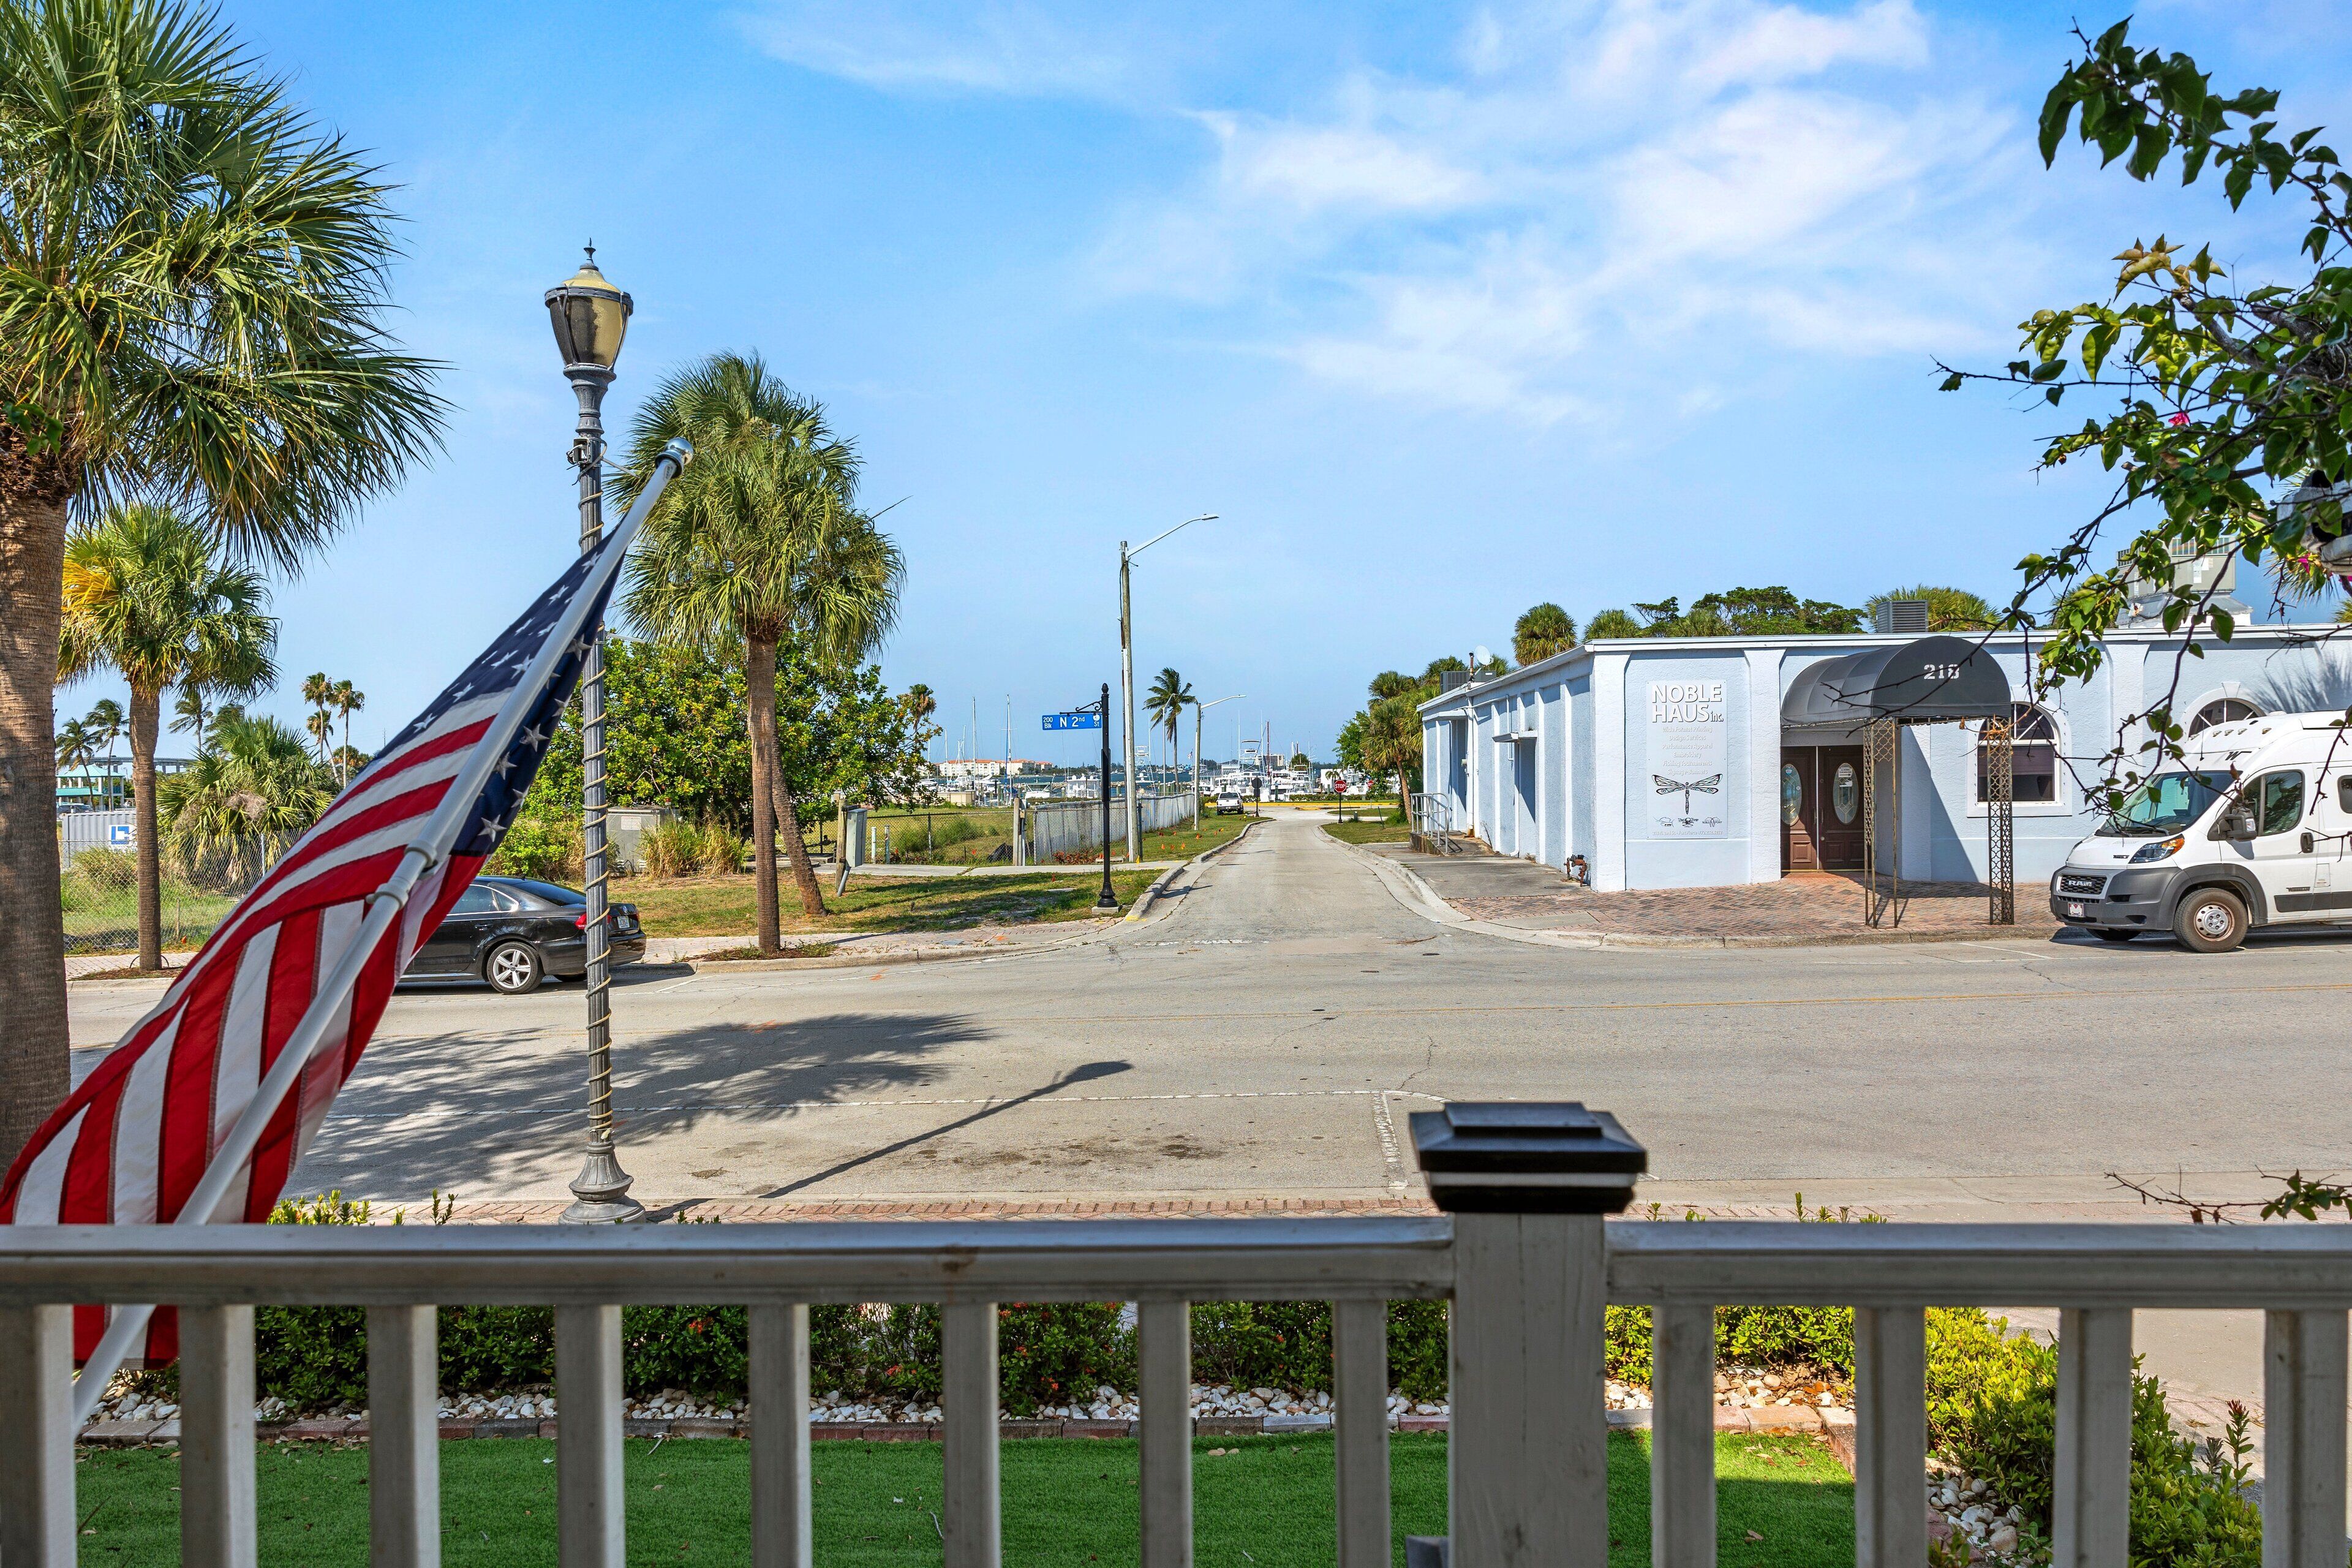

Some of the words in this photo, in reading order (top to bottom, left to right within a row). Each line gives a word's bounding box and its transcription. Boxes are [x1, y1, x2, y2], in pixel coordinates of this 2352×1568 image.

[1924, 664, 1959, 679] 218
[1652, 684, 1722, 703] NOBLE
[1060, 717, 1067, 727] N
[1071, 716, 1085, 727] 2nd
[1652, 704, 1709, 723] HAUS
[1711, 711, 1724, 722] inc.
